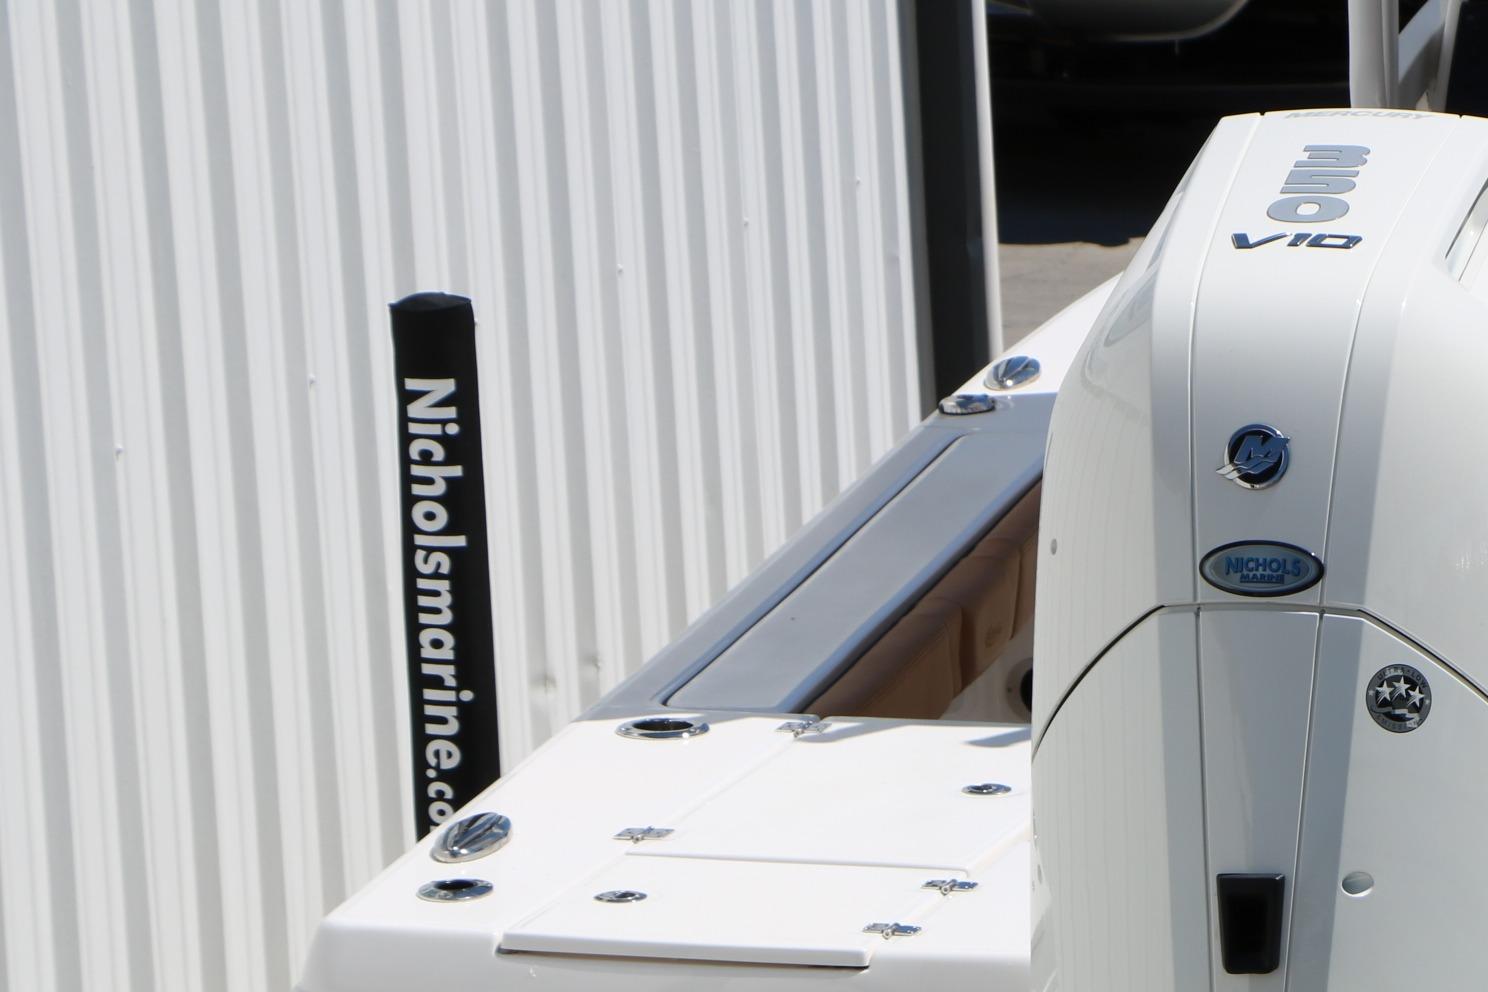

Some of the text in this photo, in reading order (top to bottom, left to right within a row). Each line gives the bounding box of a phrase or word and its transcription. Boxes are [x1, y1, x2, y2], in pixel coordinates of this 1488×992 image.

[1285, 110, 1431, 120] MERCURY
[1266, 144, 1371, 224] 350
[1231, 232, 1363, 250] V10
[1224, 556, 1303, 577] NICHOLS
[1239, 573, 1286, 583] MARINE
[403, 376, 475, 834] Nicholsmarine.co
